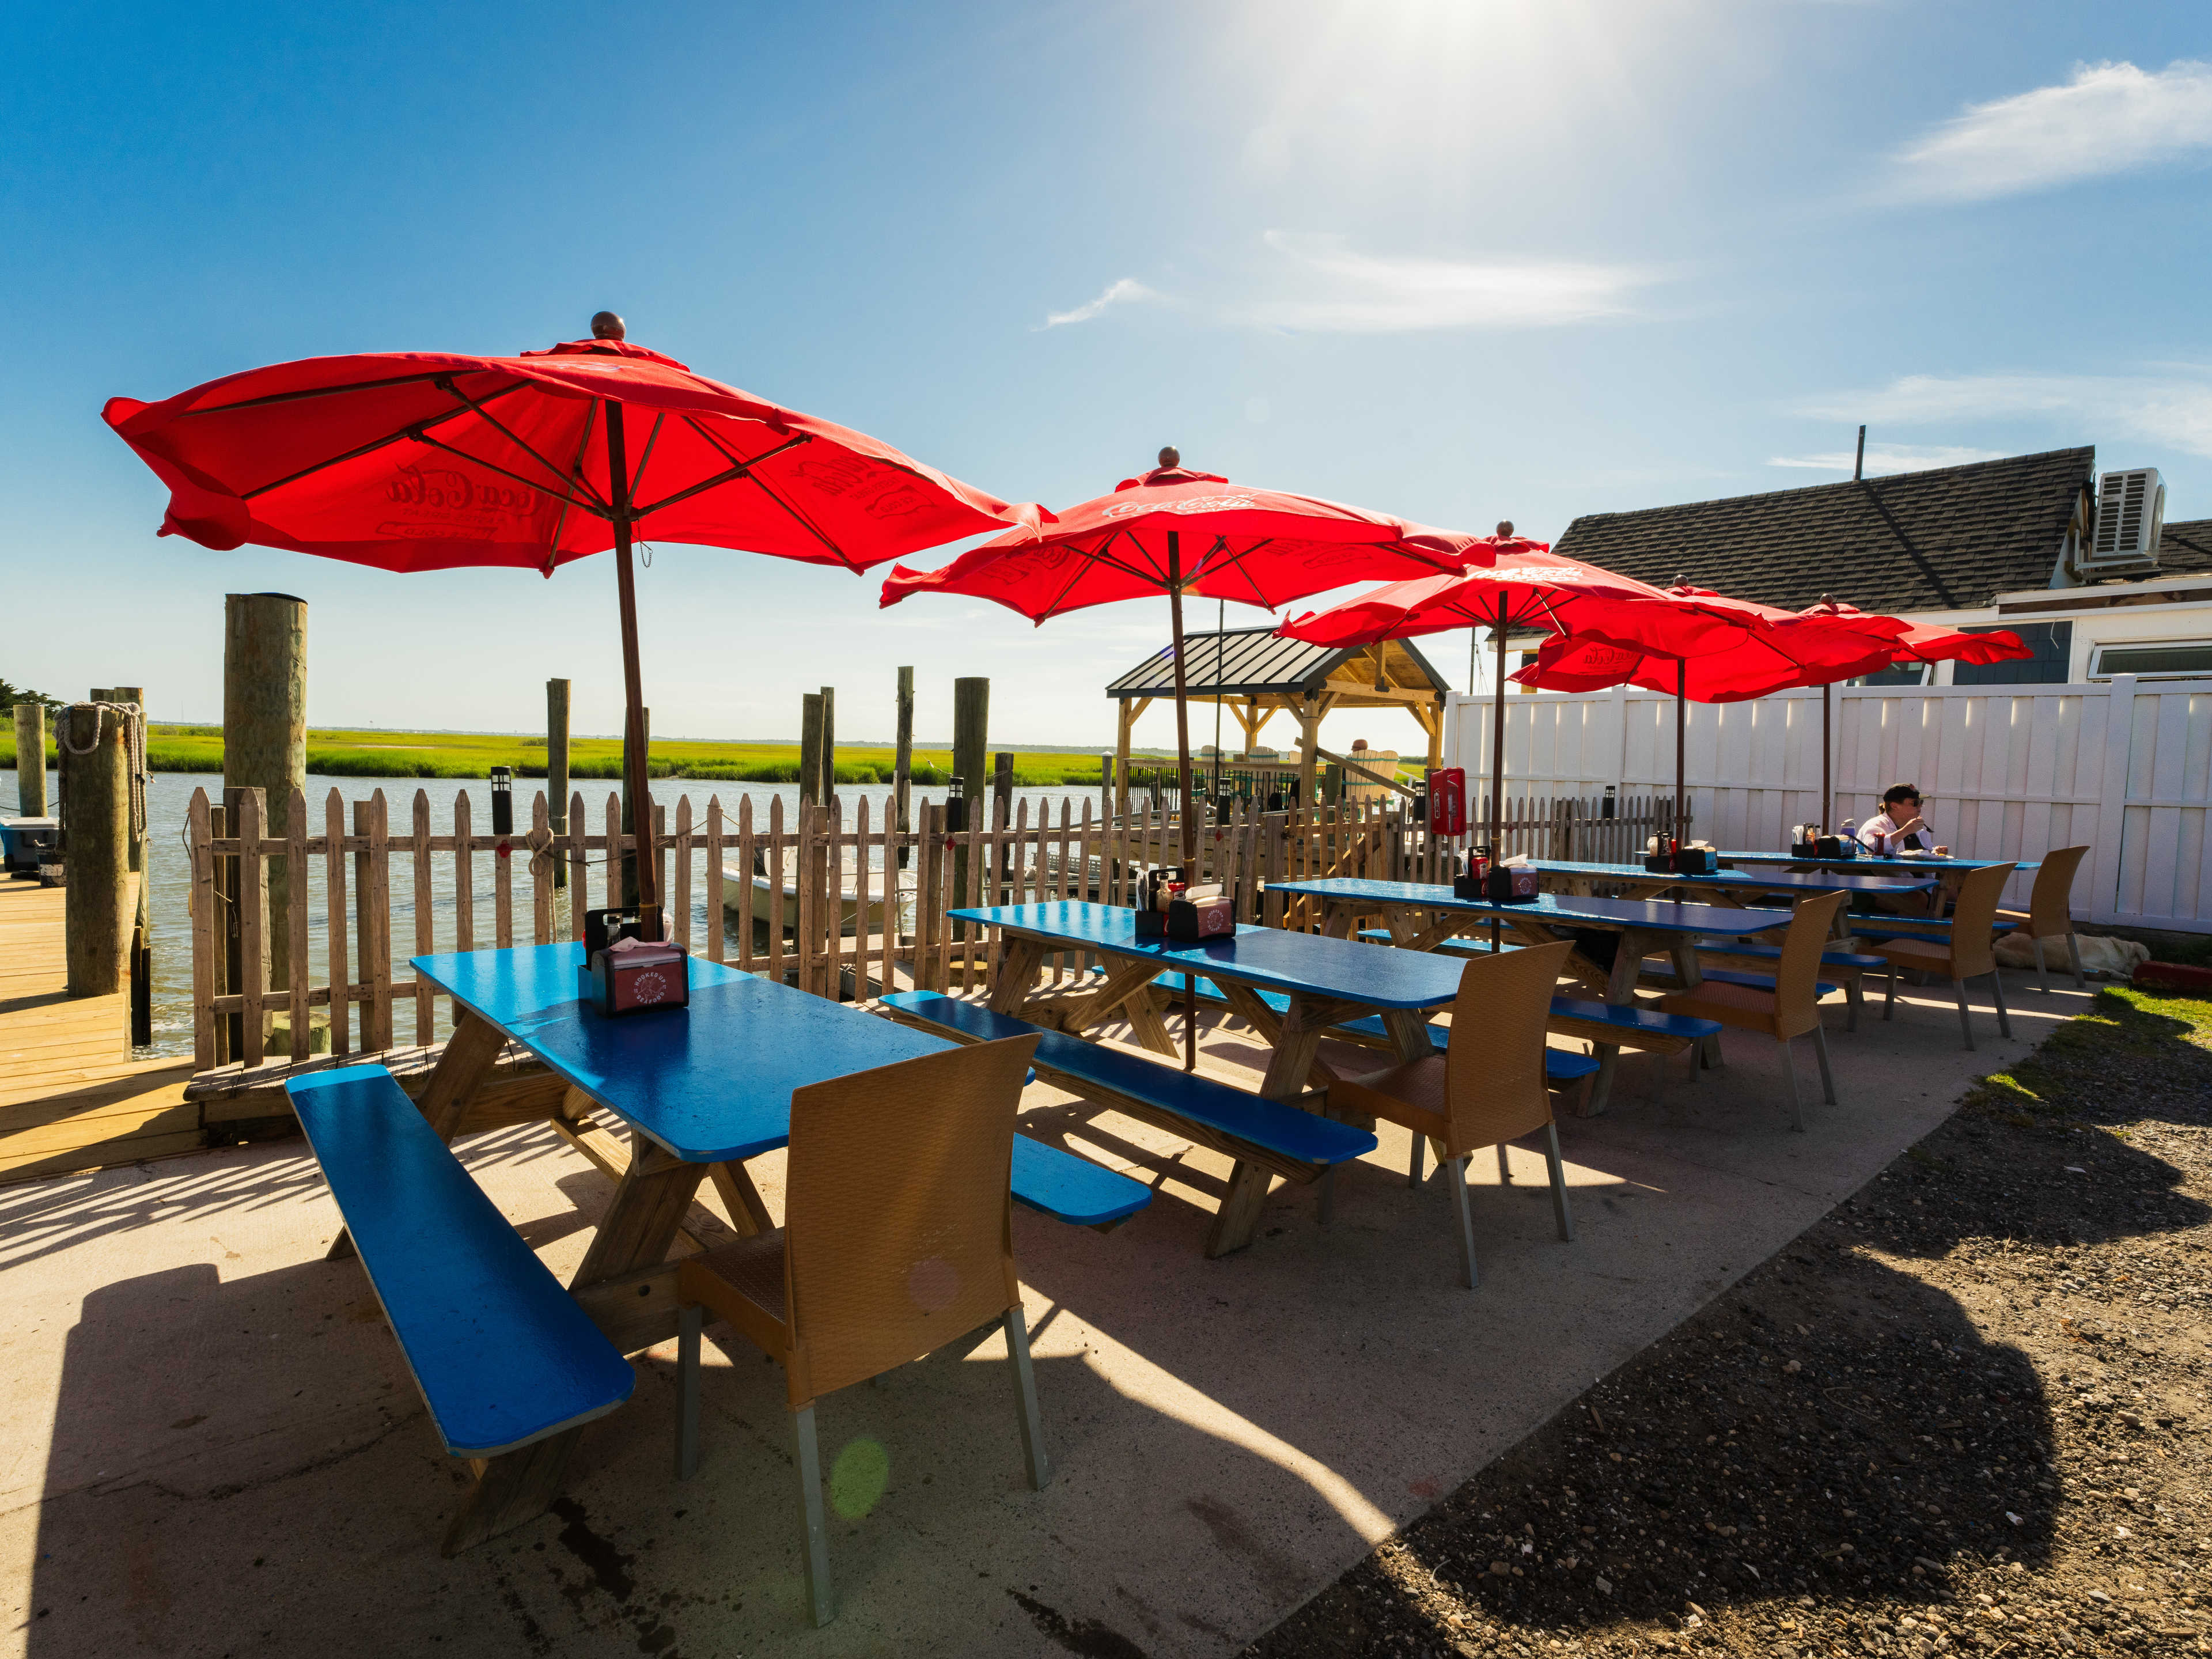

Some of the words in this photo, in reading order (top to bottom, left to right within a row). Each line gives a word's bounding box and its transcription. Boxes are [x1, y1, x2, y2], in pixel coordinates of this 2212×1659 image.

[1103, 493, 1260, 517] Coca-Cola
[634, 972, 658, 986] HOOKED
[658, 975, 666, 983] UP
[637, 991, 664, 1004] SEAFOOD
